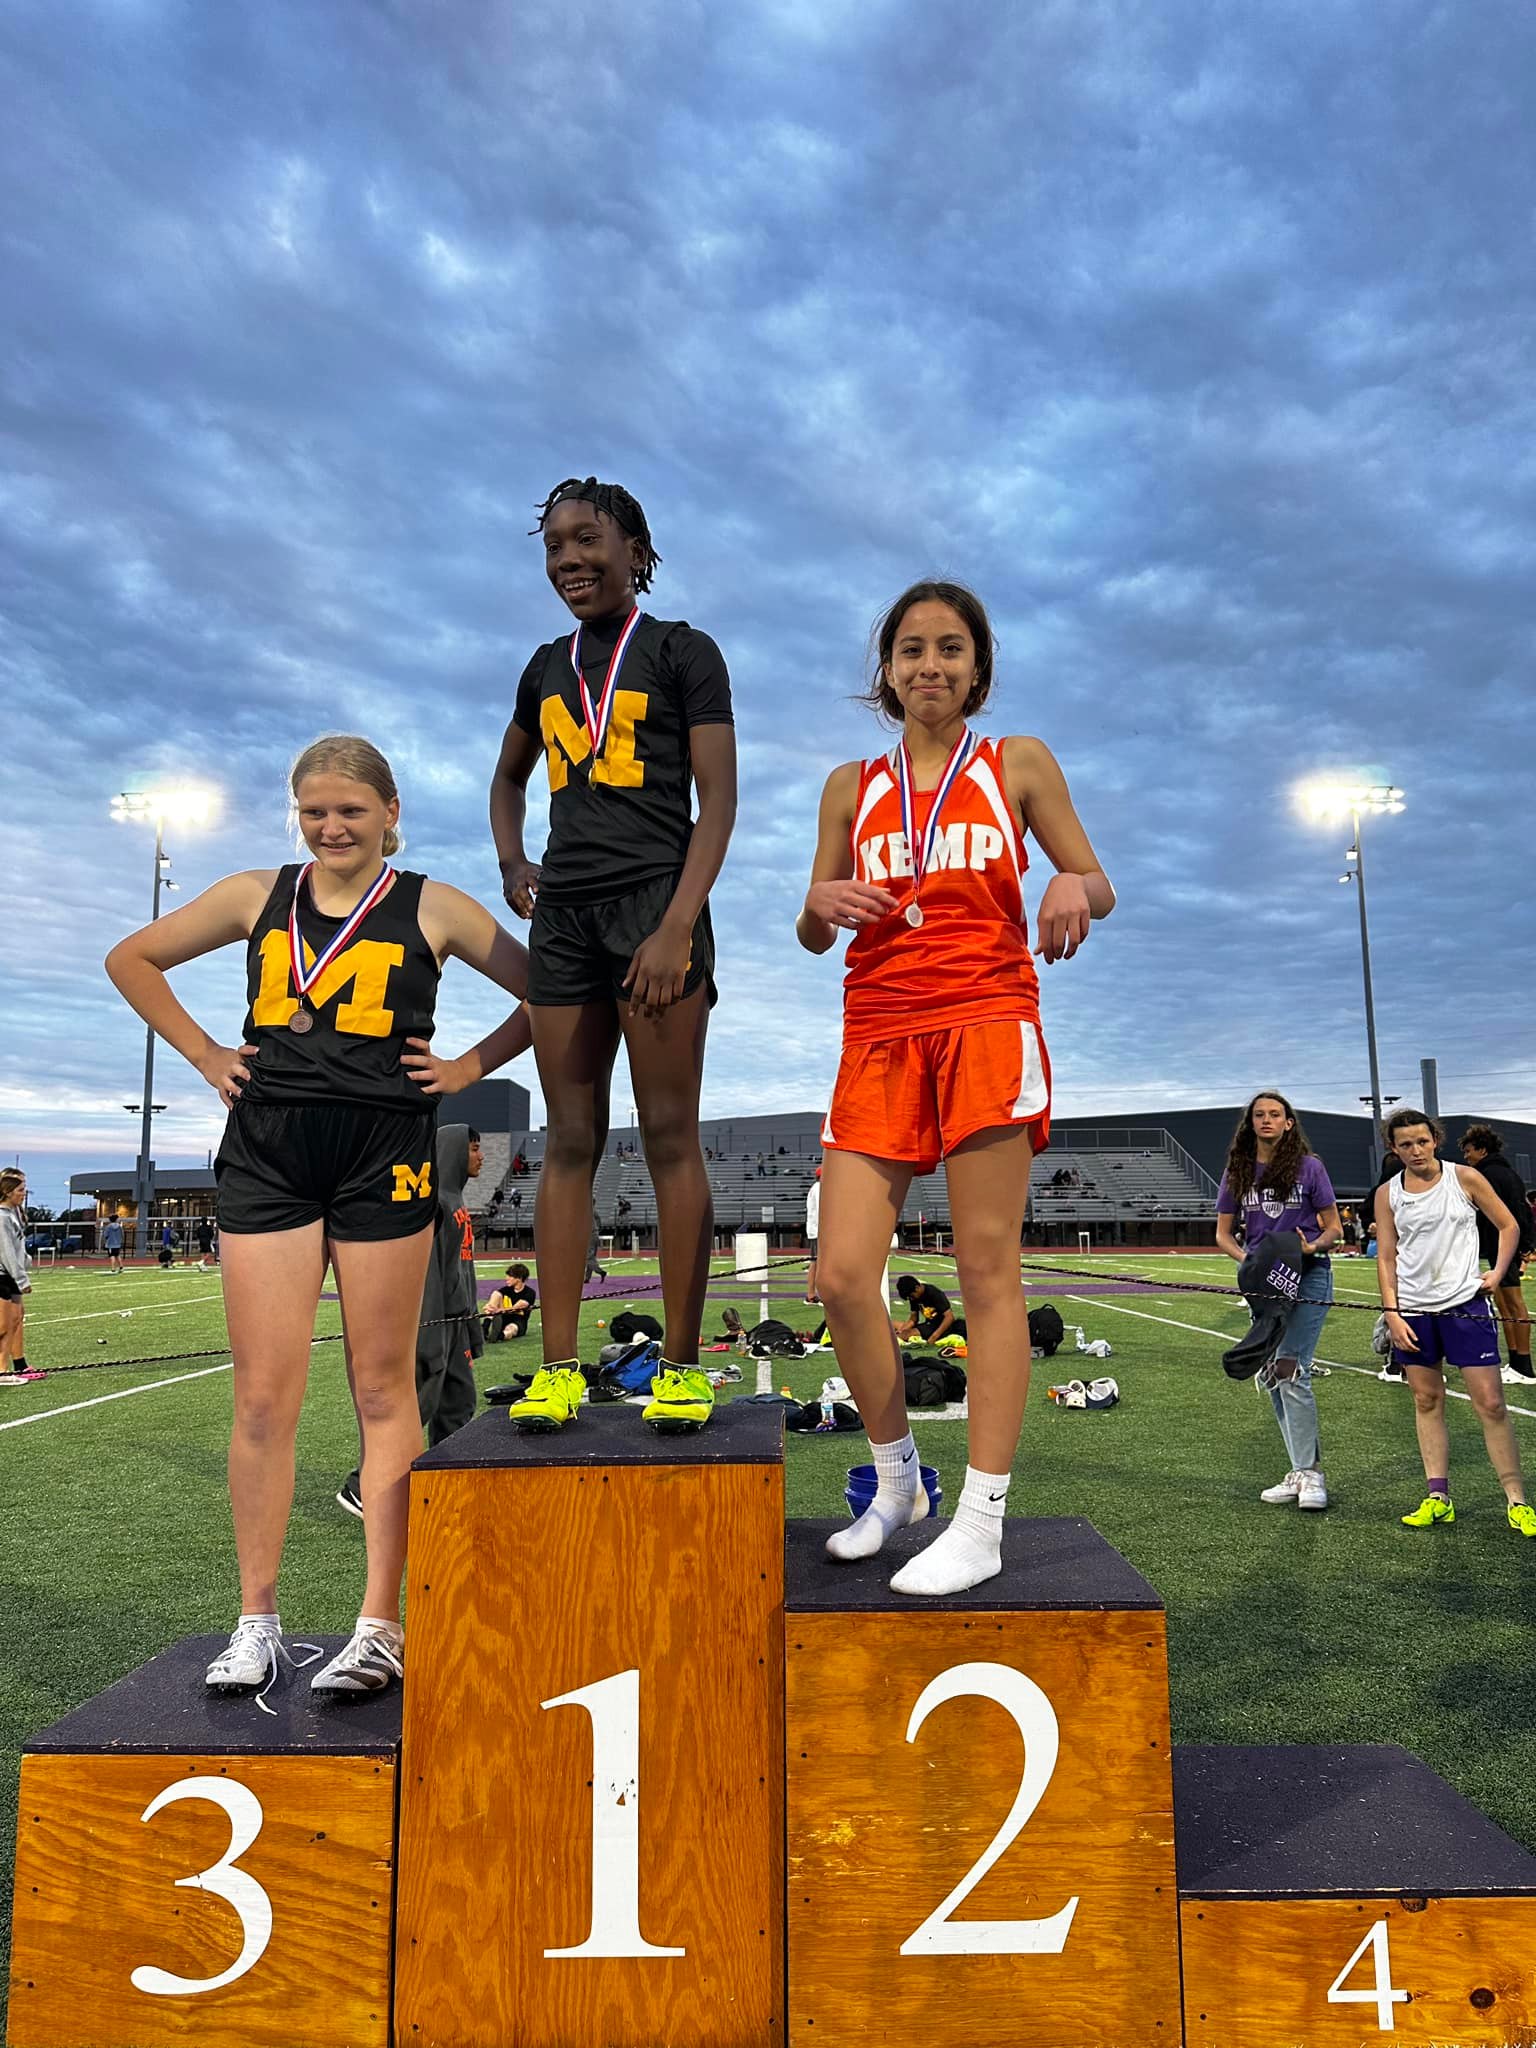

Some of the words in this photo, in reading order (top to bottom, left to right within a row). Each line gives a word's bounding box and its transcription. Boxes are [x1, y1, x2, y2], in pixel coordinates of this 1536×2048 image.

[540, 690, 648, 794] M
[859, 823, 1004, 884] KEMP
[253, 929, 405, 1038] M
[391, 1163, 432, 1202] M
[1262, 1184, 1303, 1202] TOAY
[541, 1669, 685, 1958] 1
[900, 1662, 1079, 1956] 2
[130, 1775, 273, 1995] 3
[1327, 1920, 1410, 2031] 4
